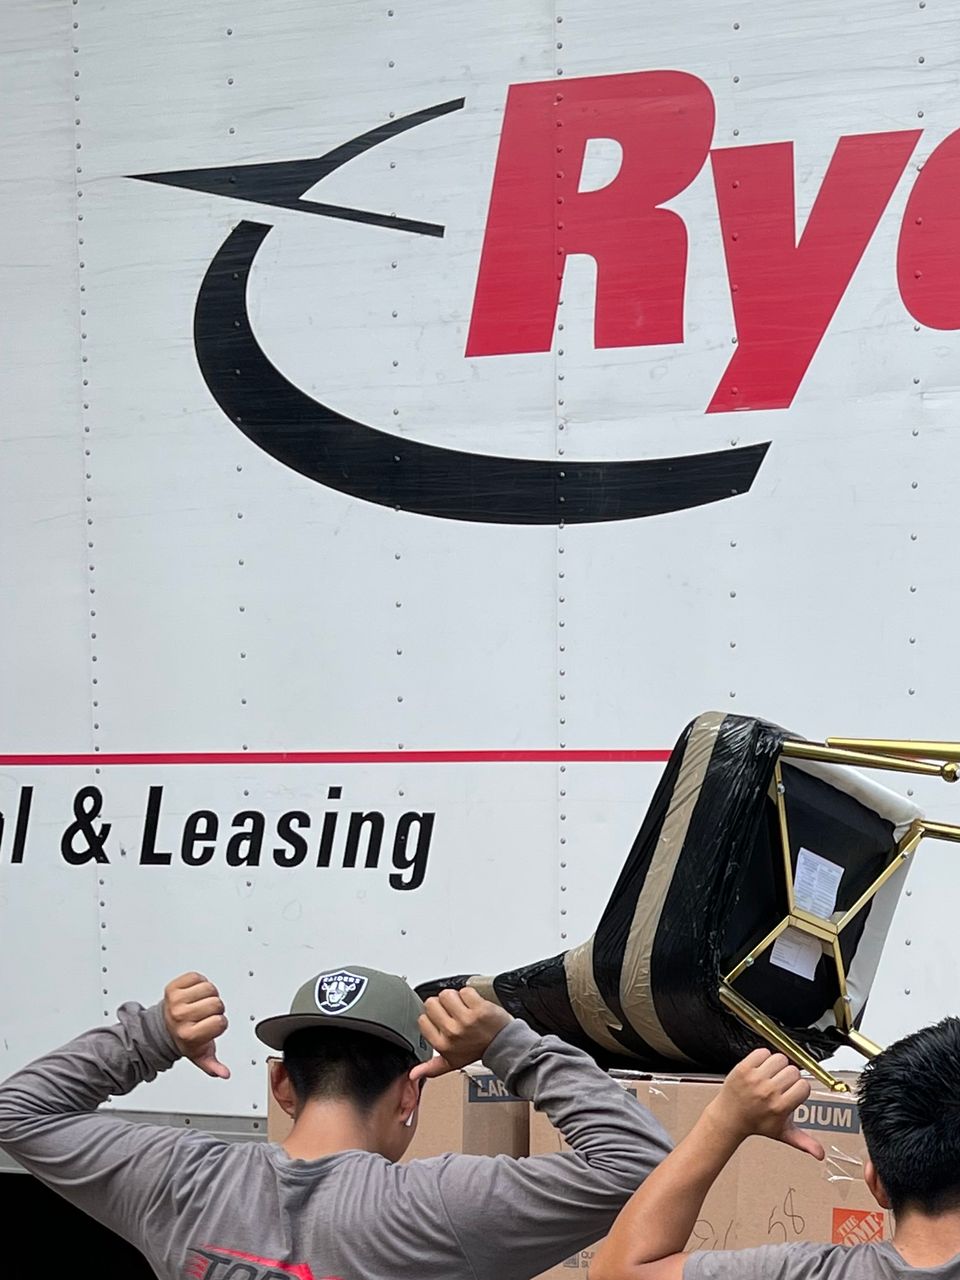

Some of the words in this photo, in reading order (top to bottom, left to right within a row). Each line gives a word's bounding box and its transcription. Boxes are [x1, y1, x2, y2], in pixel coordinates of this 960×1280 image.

[61, 786, 111, 865] &
[139, 786, 436, 891] Leasing
[477, 1079, 509, 1097] LAR
[793, 1104, 852, 1128] DIUM
